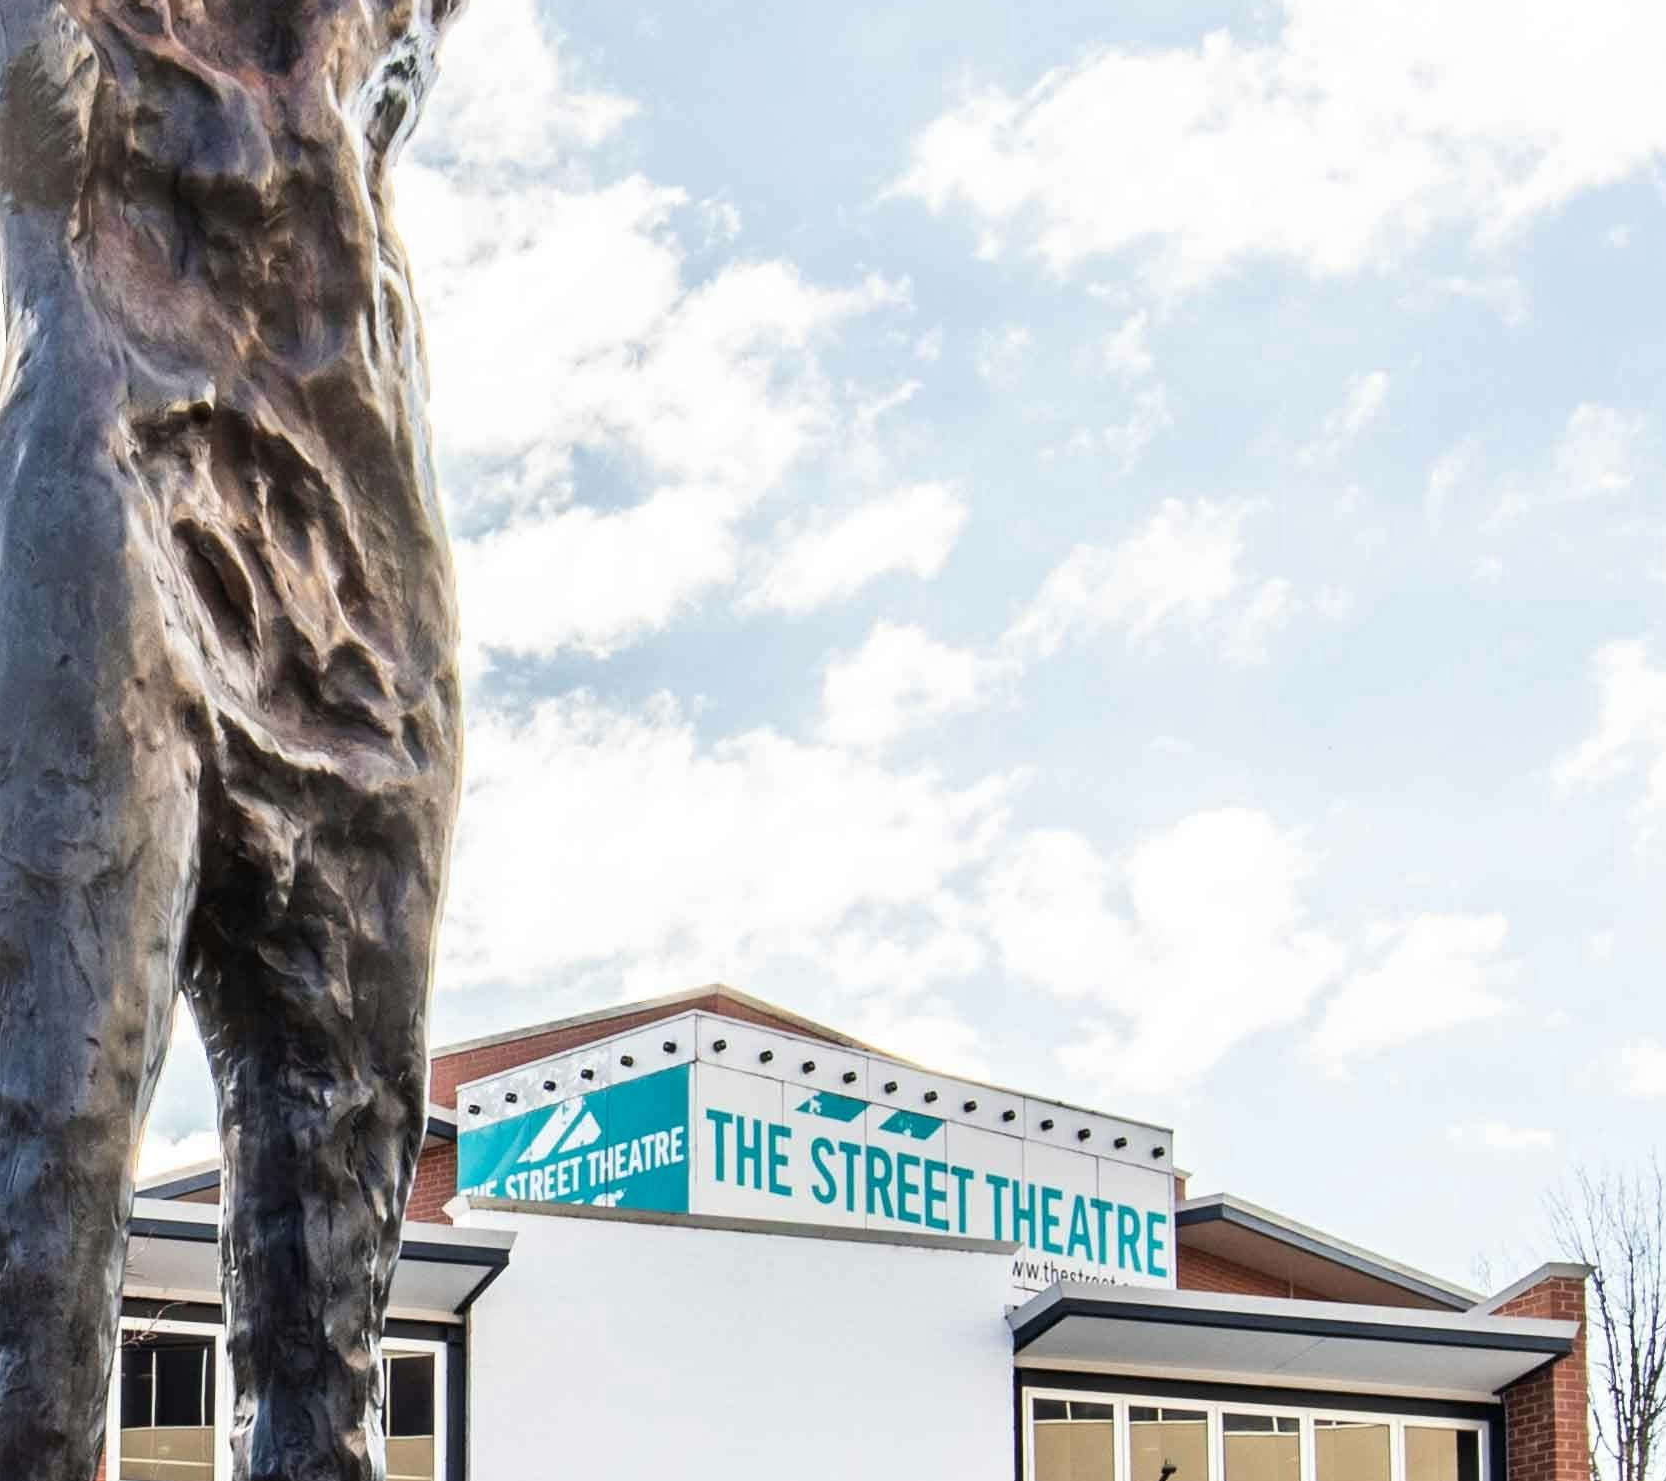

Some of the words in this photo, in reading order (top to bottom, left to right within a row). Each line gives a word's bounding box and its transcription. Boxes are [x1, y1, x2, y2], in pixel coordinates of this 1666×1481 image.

[505, 1157, 582, 1200] STREET
[587, 1126, 684, 1187] THEATRE
[706, 1108, 793, 1197] THE
[810, 1137, 974, 1233] STREET
[986, 1174, 1167, 1278] THEATRE
